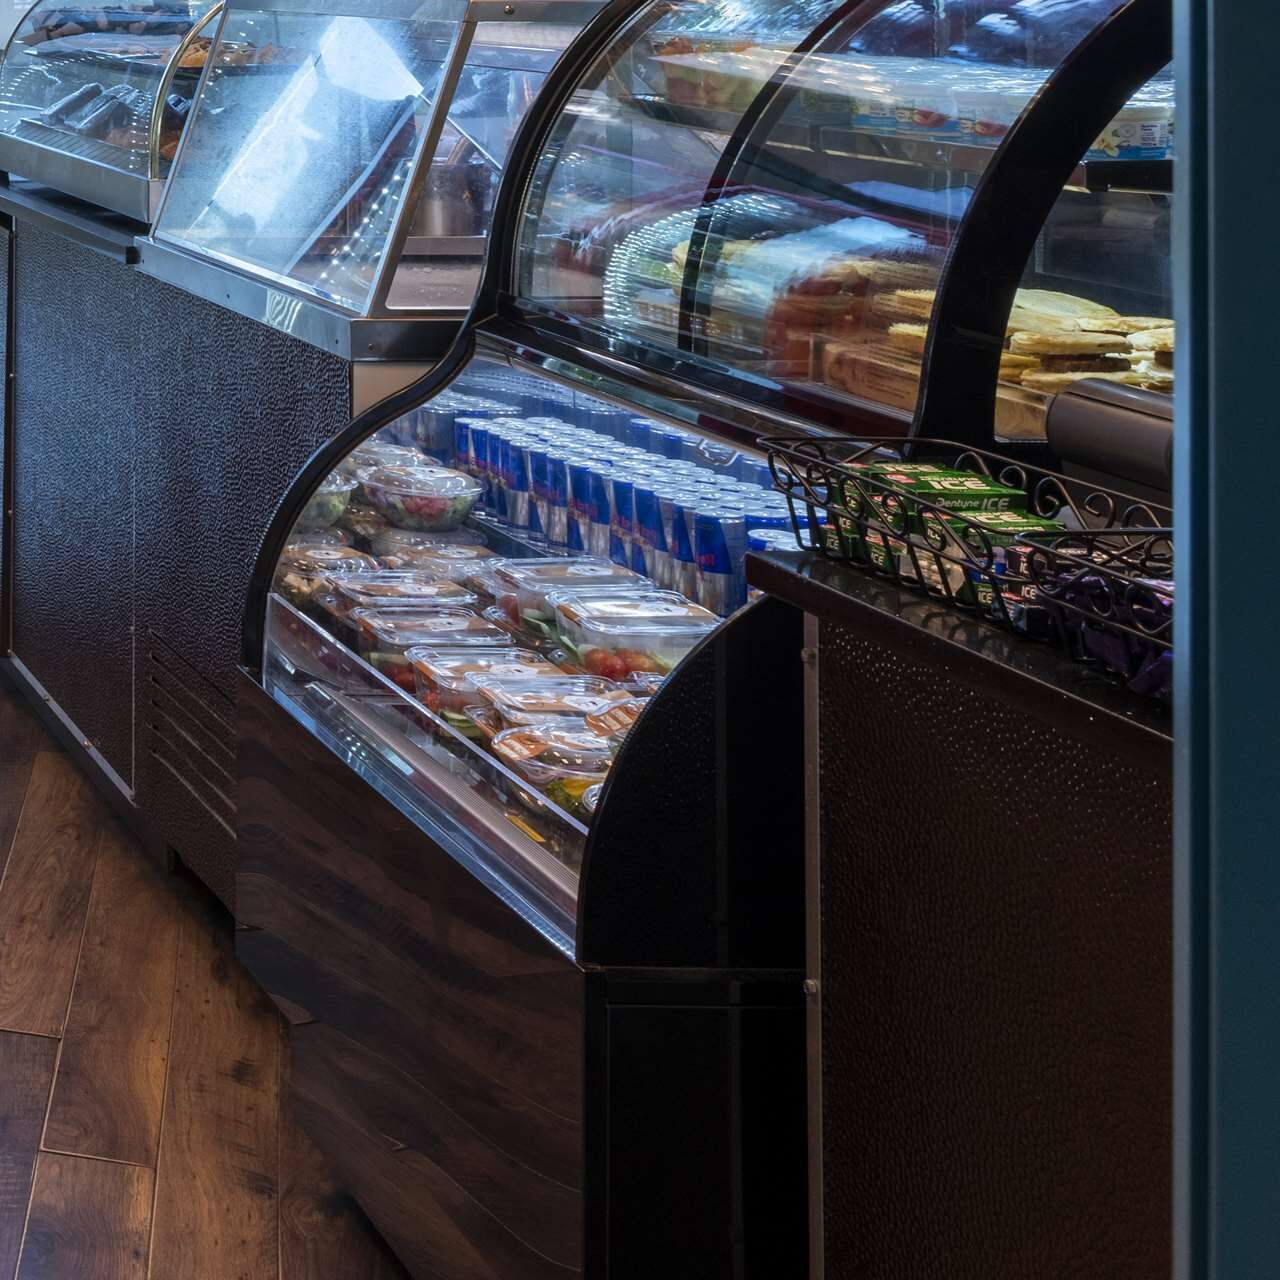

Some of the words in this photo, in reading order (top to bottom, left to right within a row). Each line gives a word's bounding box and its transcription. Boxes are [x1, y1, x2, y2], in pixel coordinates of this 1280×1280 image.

[929, 480, 992, 490] ICE
[936, 497, 980, 509] Dentyne
[981, 497, 1011, 511] ICE
[870, 552, 885, 566] ICE
[978, 591, 993, 604] ICE
[1020, 586, 1038, 600] ICE
